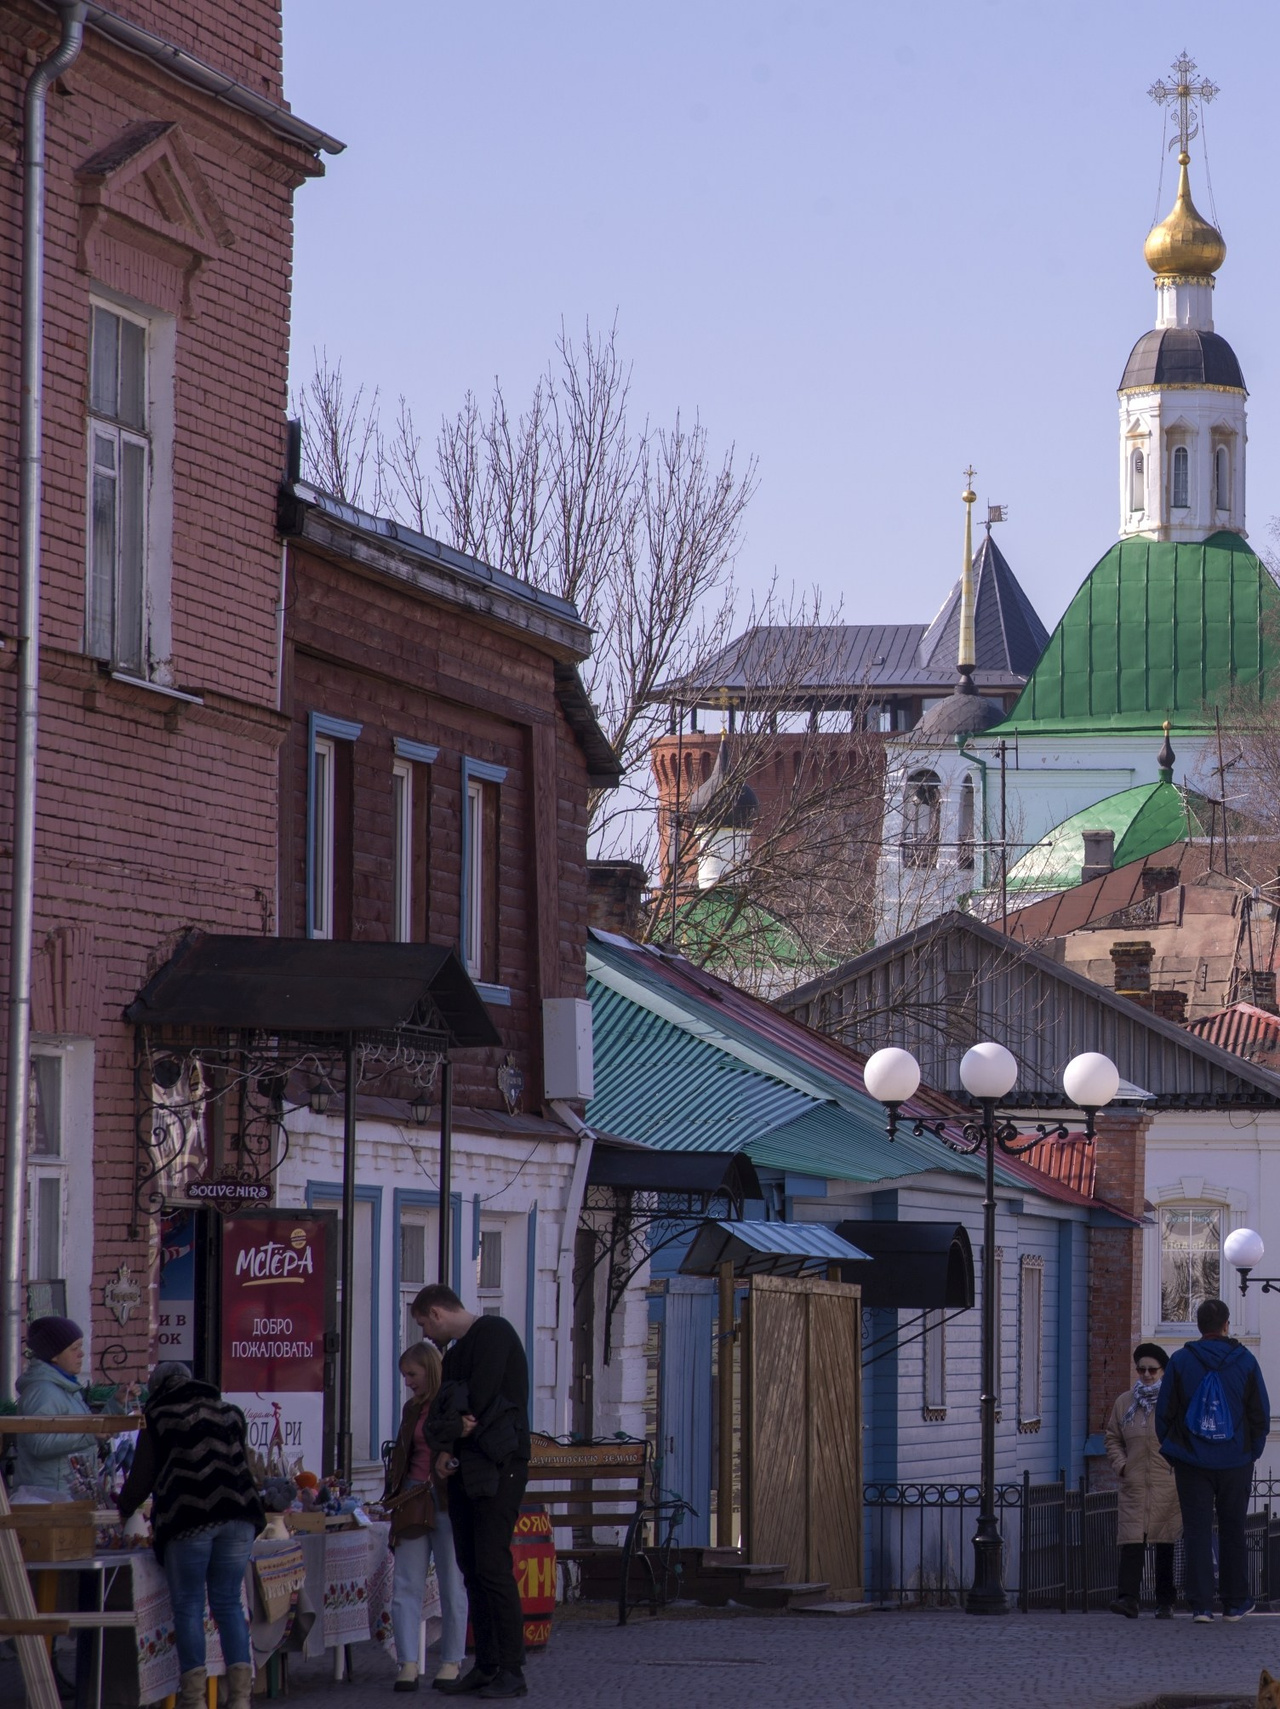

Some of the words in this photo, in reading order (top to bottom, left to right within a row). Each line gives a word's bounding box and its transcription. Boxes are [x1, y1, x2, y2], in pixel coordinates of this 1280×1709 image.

[189, 1185, 268, 1198] SOUVENIRS
[235, 1241, 313, 1277] МСТЁРА
[176, 1315, 186, 1326] В
[252, 1318, 293, 1337] ДОБРО
[158, 1333, 182, 1345] ОК
[231, 1341, 314, 1358] ПОЖАЛОВАТЬ!
